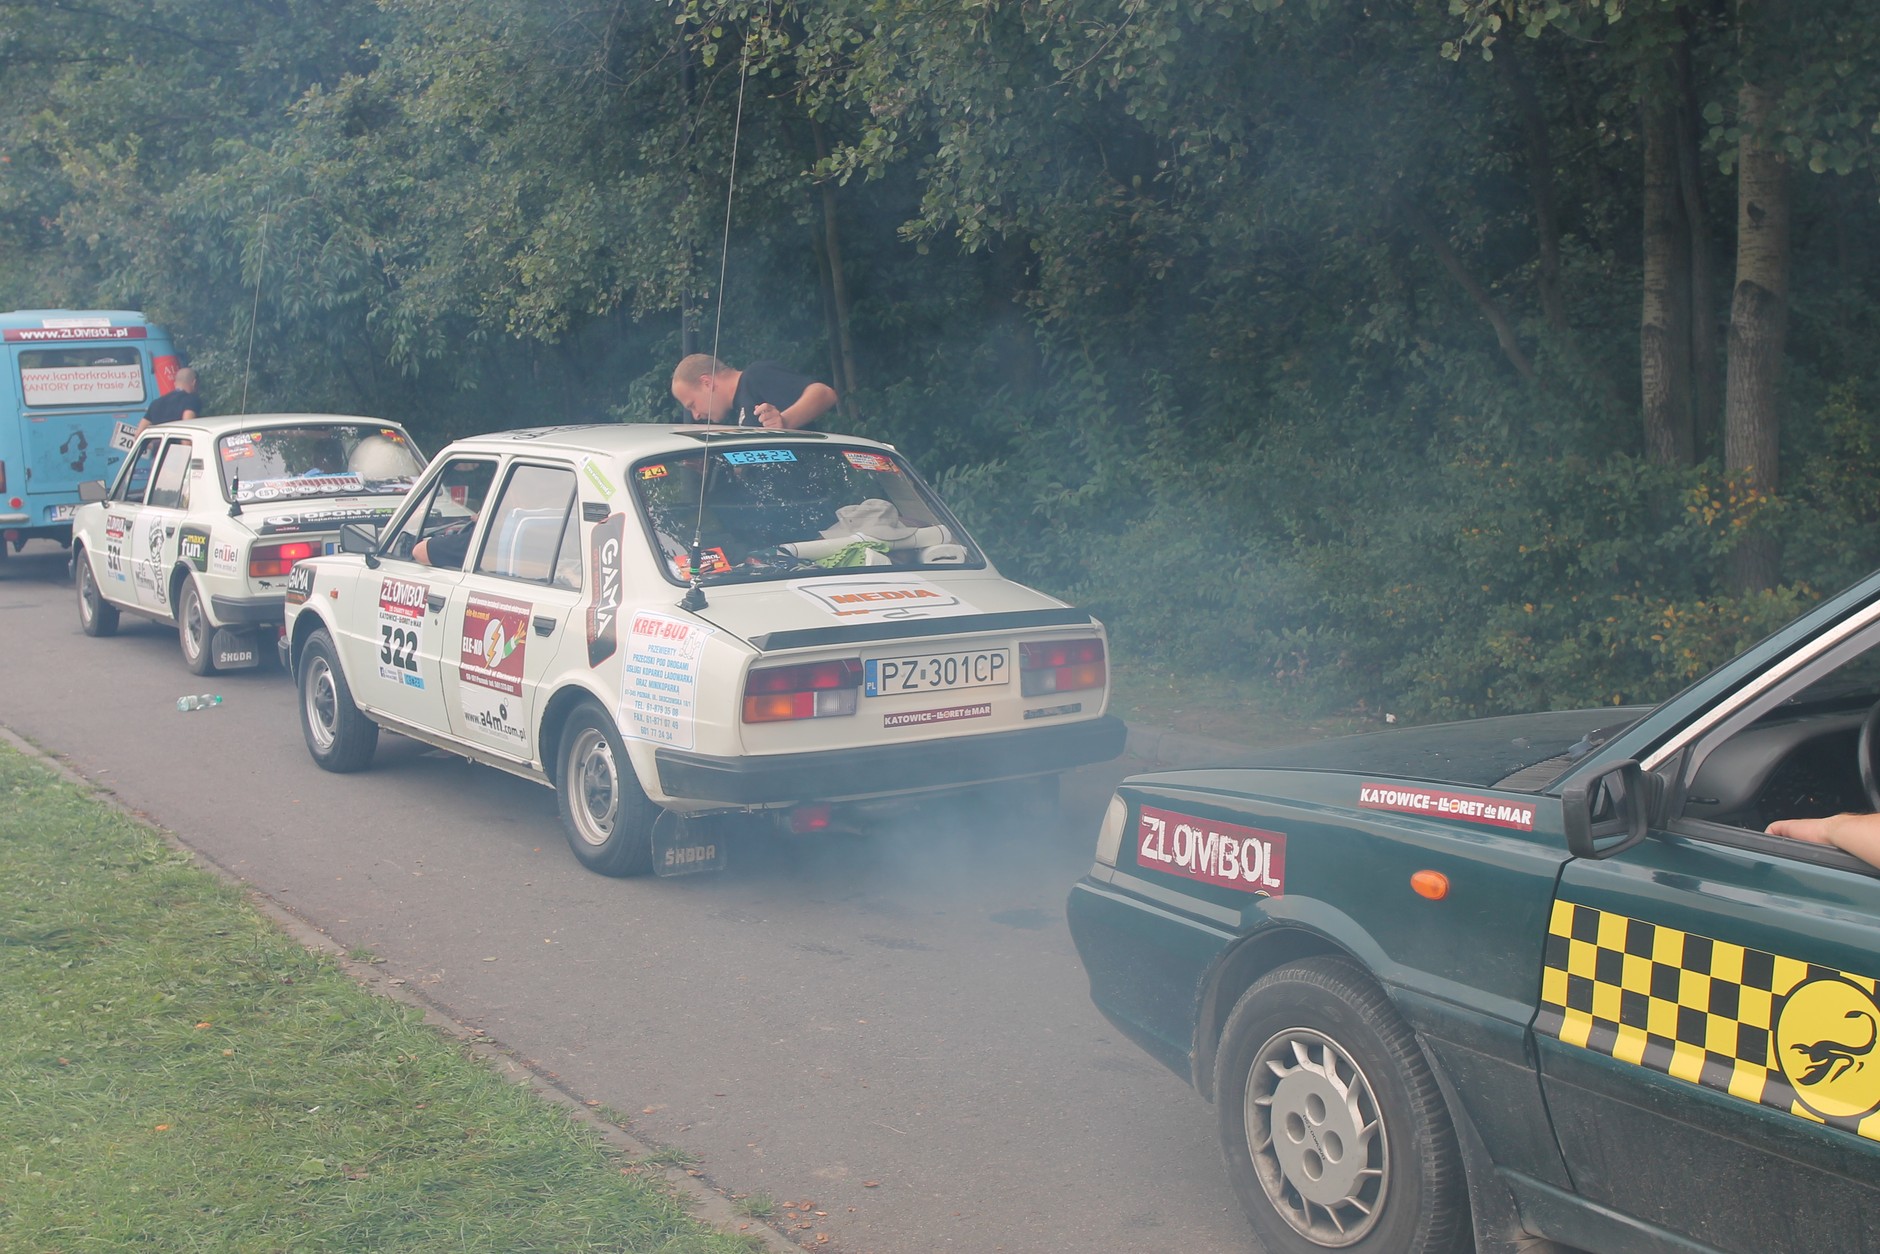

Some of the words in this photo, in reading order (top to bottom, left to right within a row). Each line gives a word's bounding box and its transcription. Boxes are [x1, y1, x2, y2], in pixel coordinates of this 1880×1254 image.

[20, 328, 128, 340] www.ZLOMBOL.pl
[22, 370, 141, 382] www.kantorkrokus.pl
[74, 382, 94, 392] przy
[97, 380, 124, 390] trasie
[128, 380, 141, 389] A2
[259, 488, 274, 496] EST
[304, 508, 397, 519] OPONYM
[187, 534, 206, 545] maxx
[181, 538, 201, 558] fun
[107, 545, 122, 572] 321
[288, 567, 309, 590] GAMA
[380, 579, 427, 609] ZLOMBOL
[597, 538, 619, 638] GAMA
[829, 589, 941, 604] MEDIA
[633, 618, 689, 640] KRET-BUD
[381, 625, 418, 672] 322
[462, 636, 483, 656] ELE-KO
[647, 644, 677, 656] PRZEWIERTY
[656, 656, 666, 667] POD
[642, 667, 664, 678] KOPARKO
[882, 660, 919, 691] PZ
[929, 653, 1004, 686] 301CP
[636, 678, 648, 688] ORAZ
[867, 682, 876, 690] PL
[971, 706, 991, 716] MAR
[671, 721, 679, 730] 49
[651, 728, 658, 737] 77
[1484, 804, 1497, 819] de
[1497, 806, 1532, 826] MAR
[665, 845, 716, 865] ŠKODA
[1141, 813, 1282, 888] ZLOMBOL
